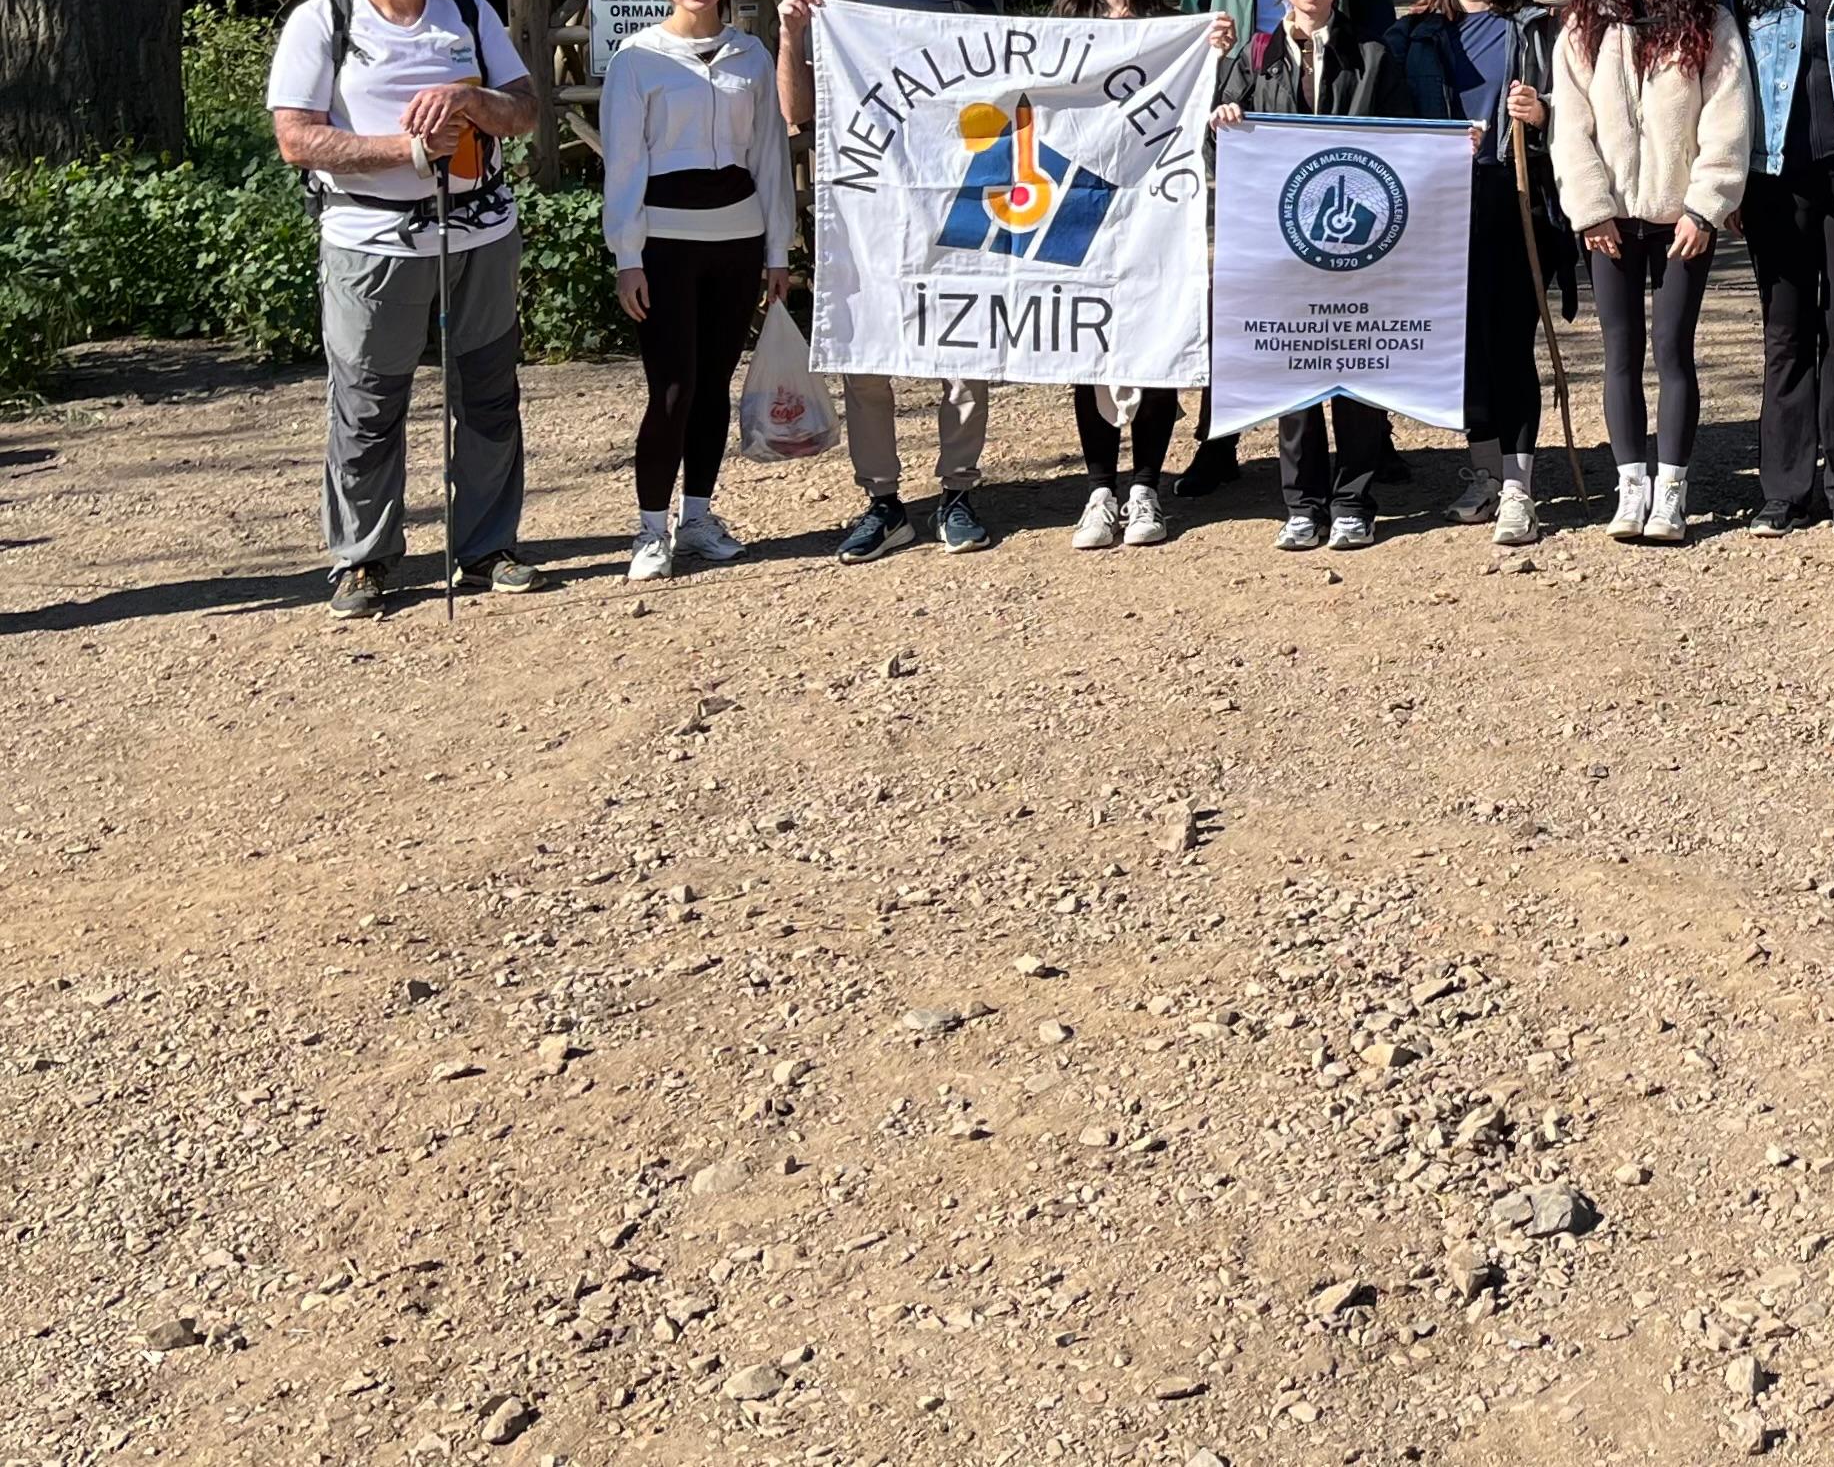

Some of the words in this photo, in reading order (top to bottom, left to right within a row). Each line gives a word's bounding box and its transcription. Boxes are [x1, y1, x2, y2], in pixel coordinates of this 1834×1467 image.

[610, 5, 675, 17] ORMANA
[832, 30, 1096, 194] METALURJİ
[1103, 64, 1201, 203] GENÇ
[1306, 160, 1320, 172] VE
[1320, 152, 1368, 166] MALZEME
[1284, 168, 1309, 219] METALURJİ
[1285, 220, 1309, 255] TMMOB
[1378, 225, 1400, 251] ODASI
[1329, 258, 1358, 268] 1970
[1308, 302, 1369, 315] TMMOB
[917, 282, 1113, 353] İZMİR
[1244, 319, 1329, 333] METALURJİ
[1332, 321, 1352, 333] VE
[1355, 320, 1432, 332] MALZEME
[1254, 336, 1372, 351] MÜHENDİSLERİ
[1375, 337, 1424, 351] ODASI
[1288, 355, 1332, 370] İZMİR
[1336, 355, 1389, 373] ŞUBESİ
